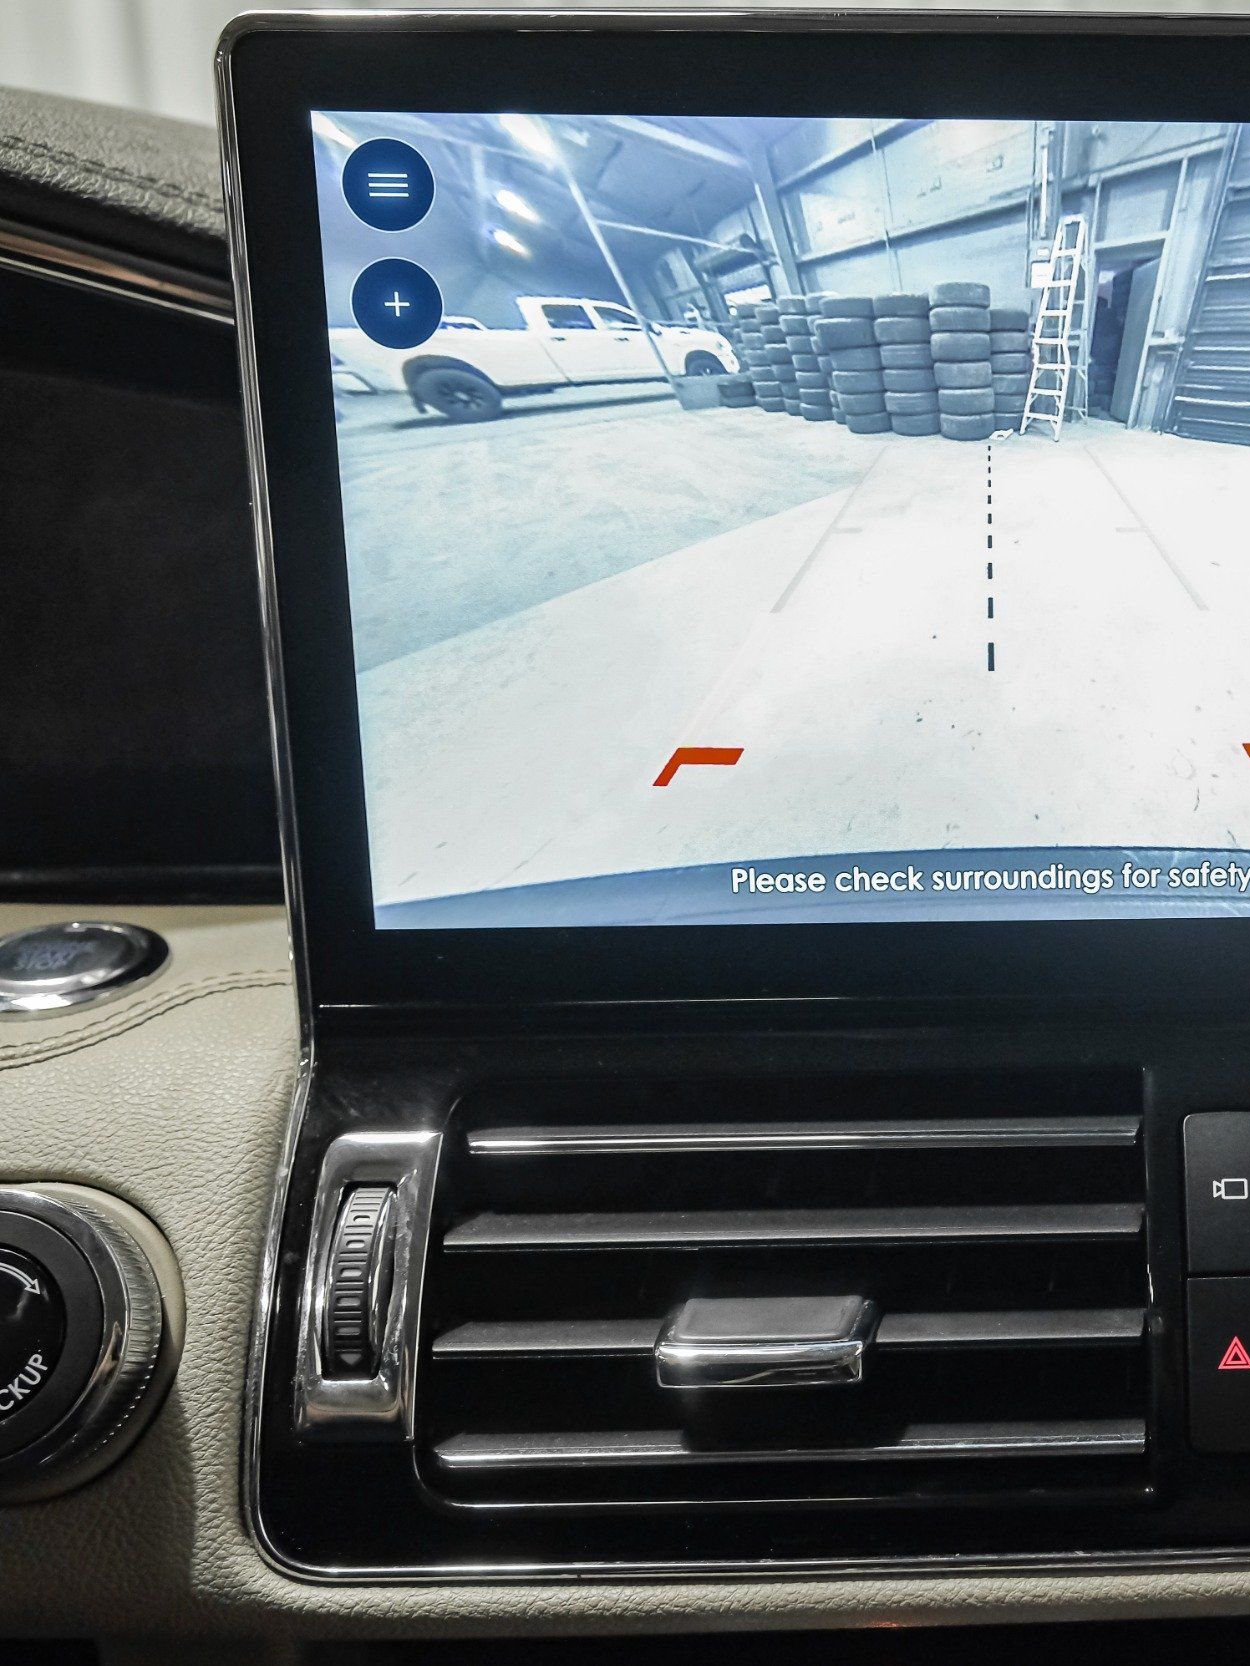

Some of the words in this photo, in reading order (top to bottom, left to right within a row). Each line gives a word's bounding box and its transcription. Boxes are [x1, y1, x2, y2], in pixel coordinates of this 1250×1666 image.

[731, 867, 826, 893] Please
[834, 864, 925, 892] check
[931, 863, 1114, 894] surroundings
[1121, 861, 1161, 888] for
